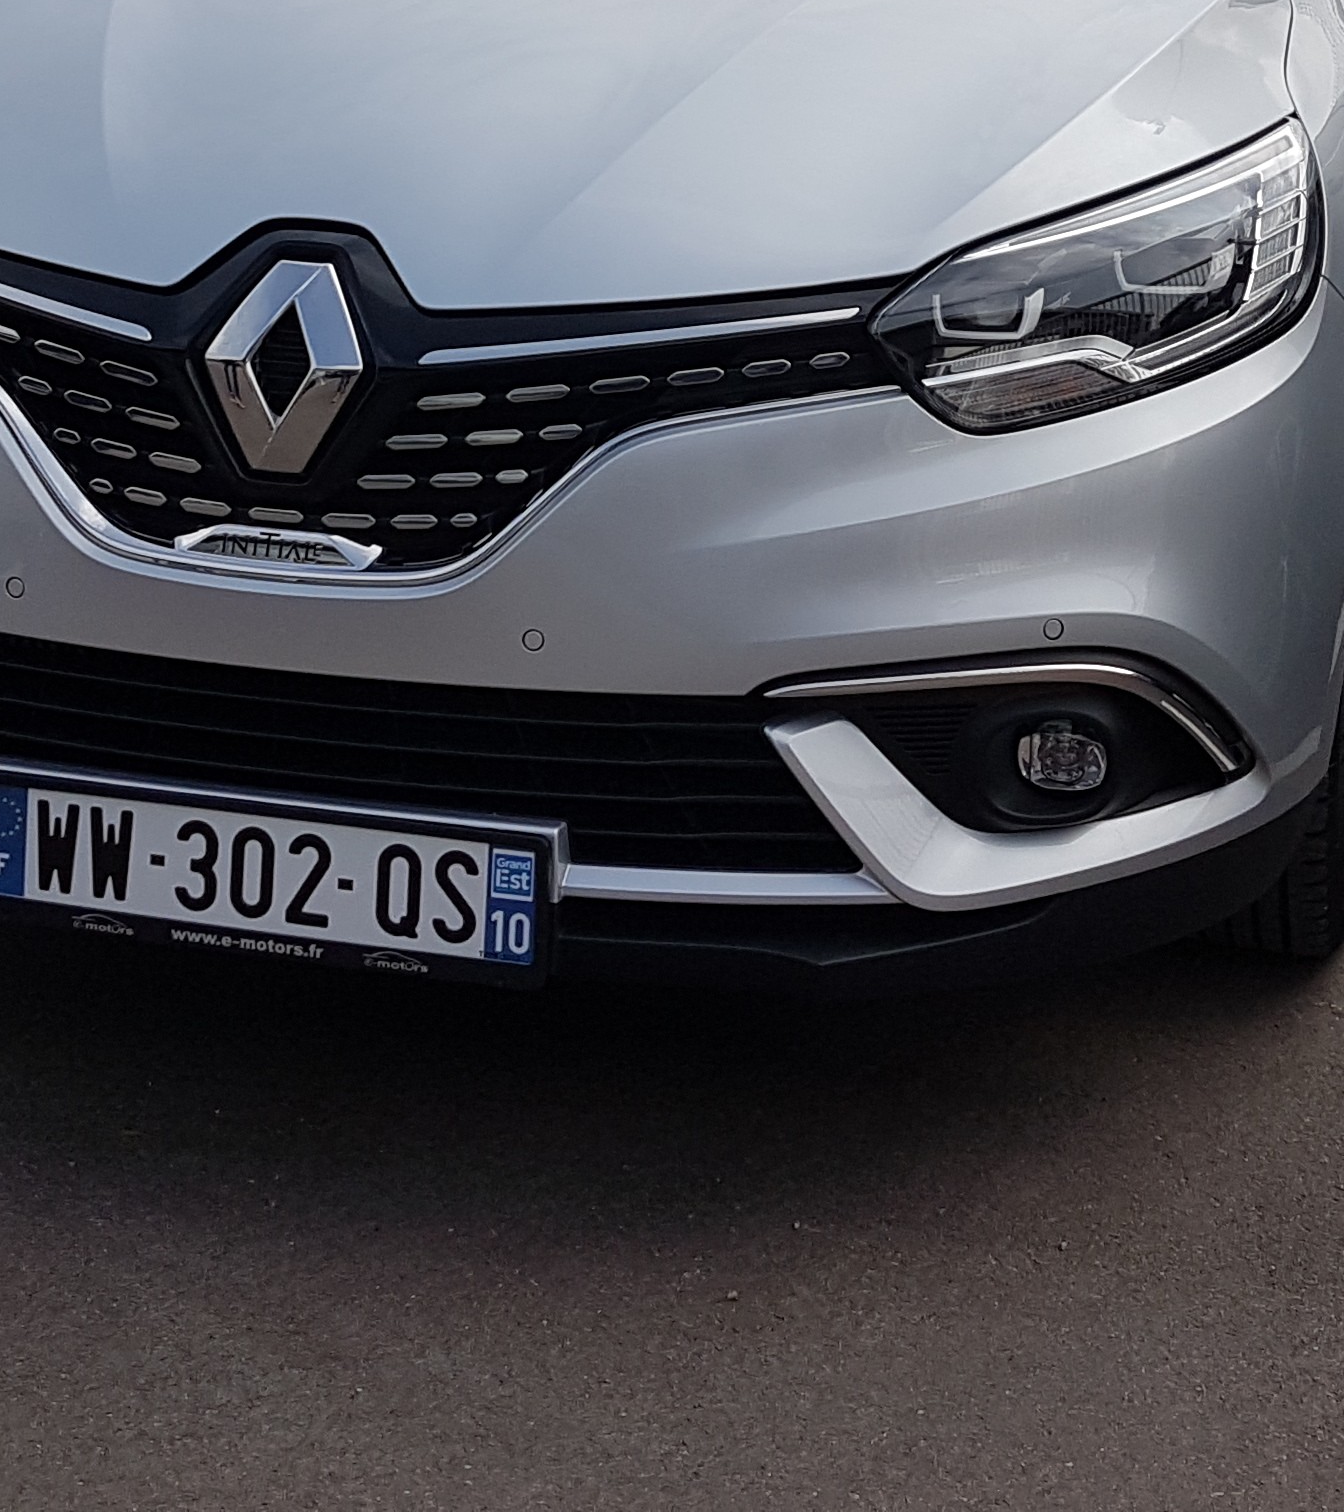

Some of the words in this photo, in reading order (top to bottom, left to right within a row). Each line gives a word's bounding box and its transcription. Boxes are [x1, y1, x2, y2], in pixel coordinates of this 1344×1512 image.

[496, 857, 532, 871] Grand
[496, 868, 531, 891] Est
[171, 927, 324, 959] www.e-motors.fr
[490, 909, 531, 955] 10
